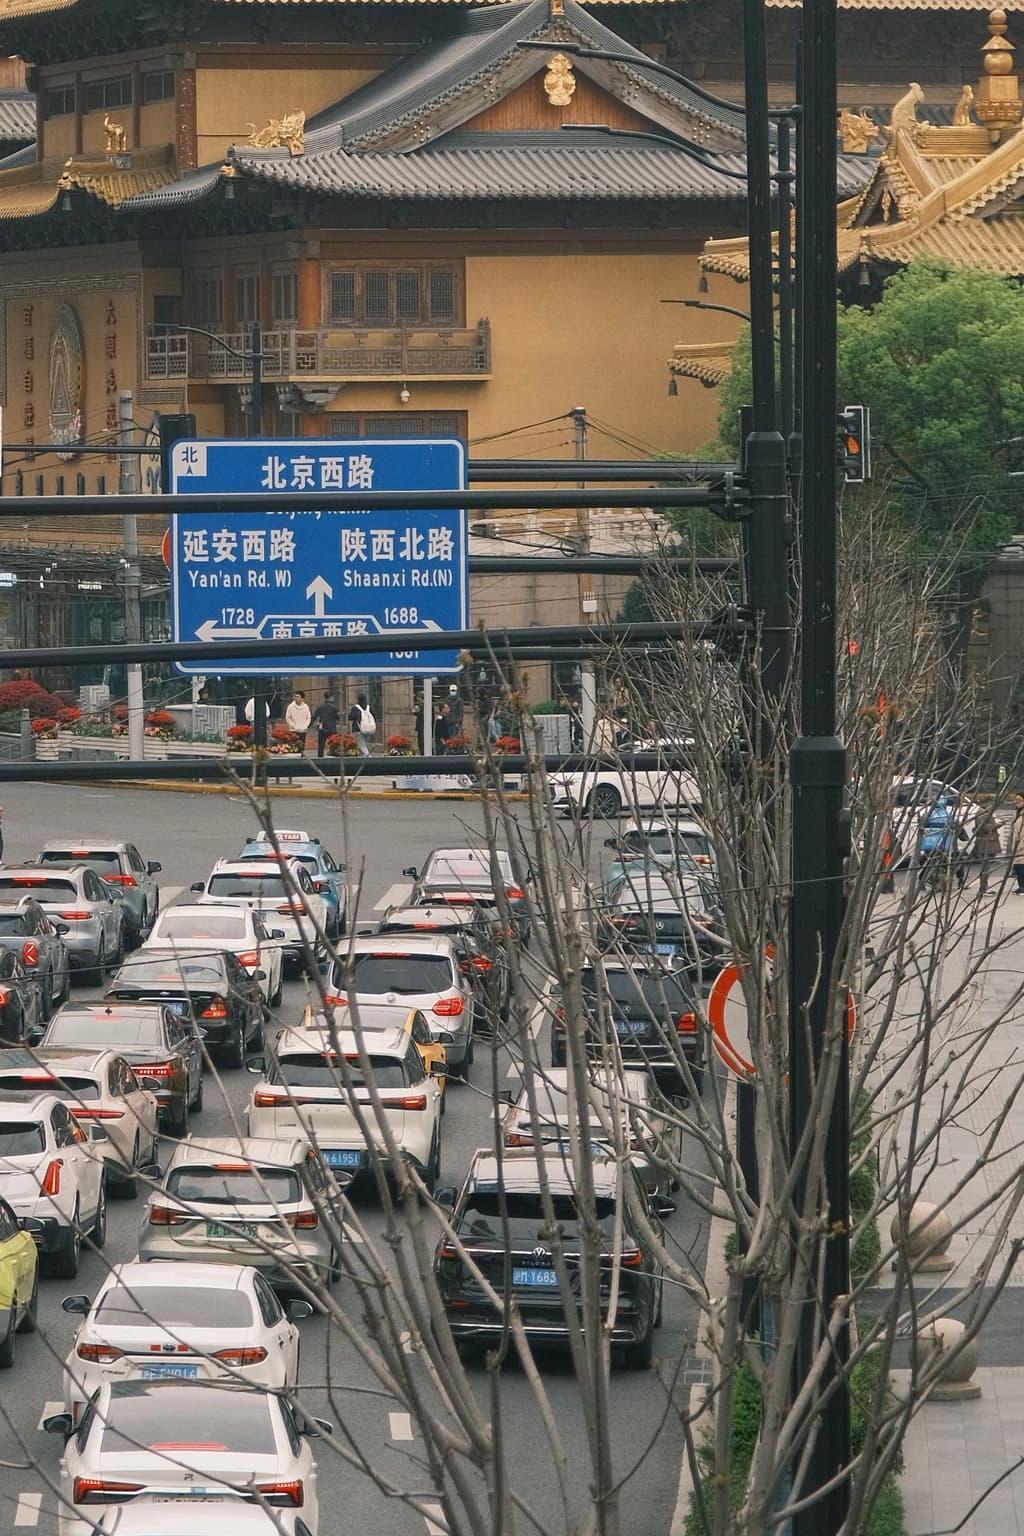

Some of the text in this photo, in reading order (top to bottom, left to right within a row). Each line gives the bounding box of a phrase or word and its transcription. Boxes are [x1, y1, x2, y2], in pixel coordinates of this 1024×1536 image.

[181, 446, 198, 463] 北
[261, 454, 375, 489] 北京西路
[183, 527, 297, 563] 延安西路
[341, 526, 455, 563] 陕西北路
[188, 570, 242, 588] Yan'an
[248, 570, 270, 587] Rd.
[343, 569, 406, 587] Shaanxi
[221, 607, 255, 625] 1728
[384, 607, 418, 624] 1688
